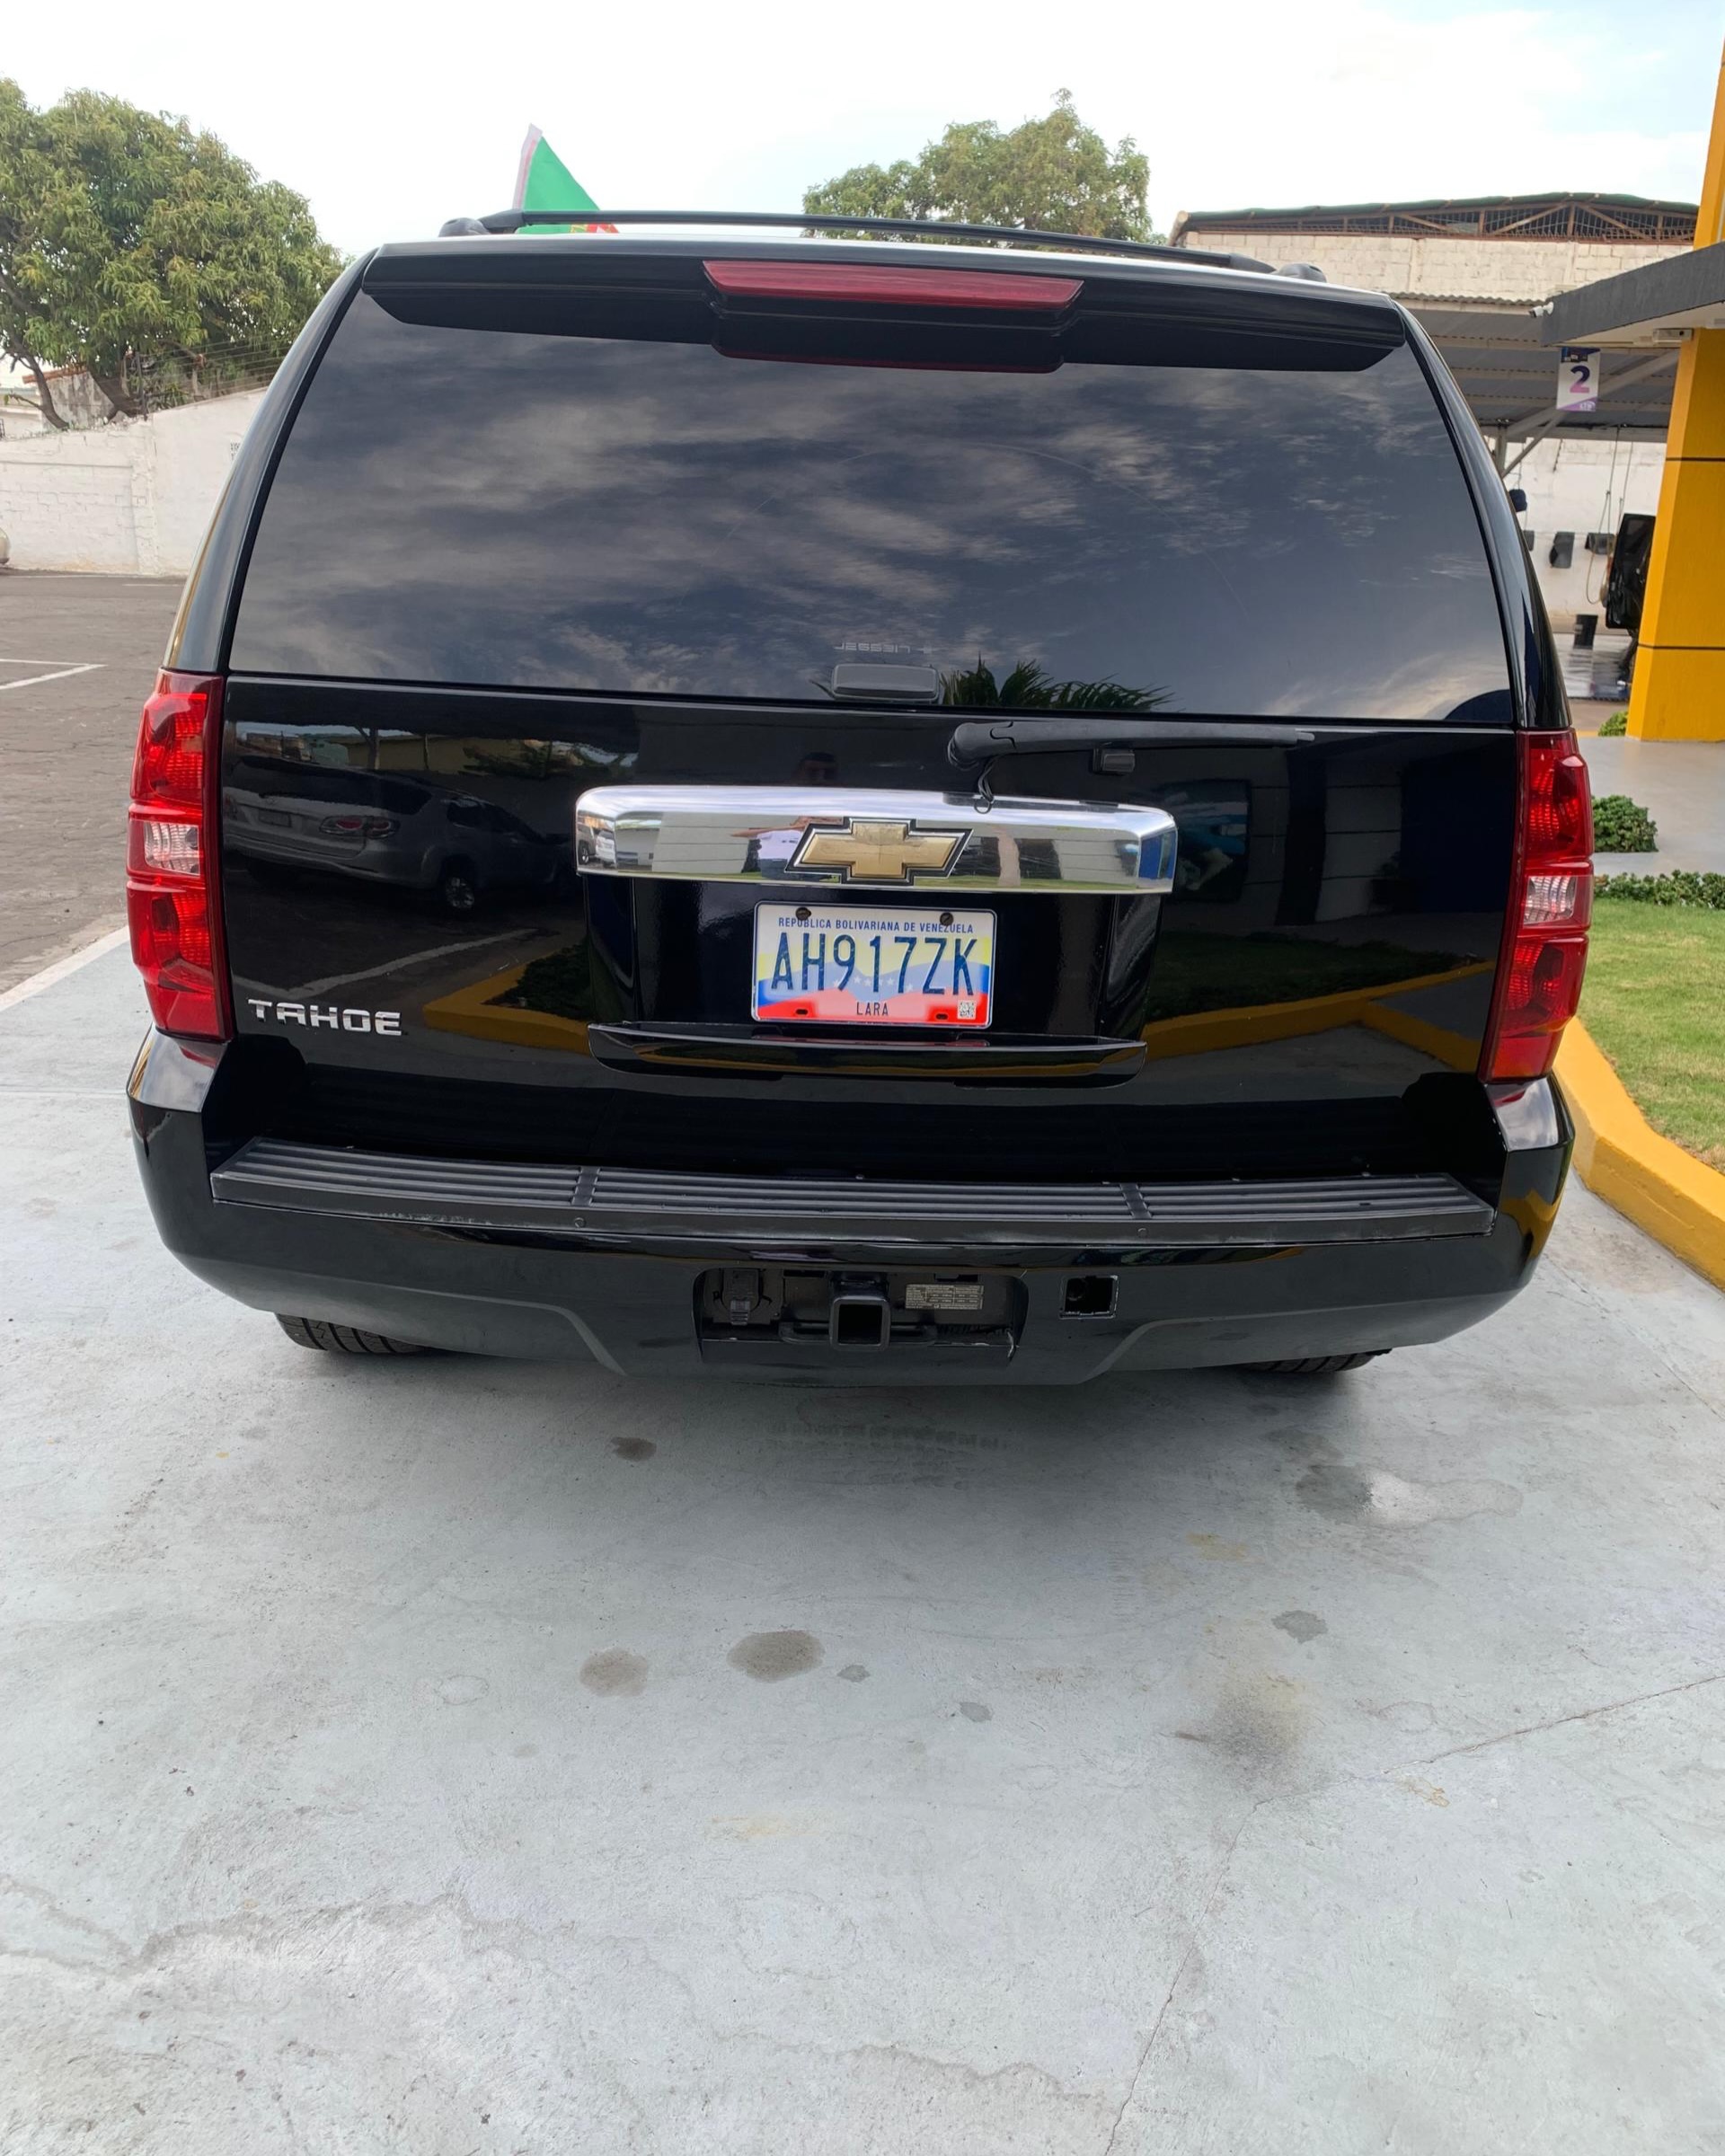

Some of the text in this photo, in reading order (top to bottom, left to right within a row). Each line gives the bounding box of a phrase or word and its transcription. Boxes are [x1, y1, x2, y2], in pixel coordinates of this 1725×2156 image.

[1570, 365, 1590, 393] 2
[836, 919, 899, 932] BOLIVARIANA
[904, 922, 916, 932] DE
[919, 923, 974, 934] VENEZUELA
[771, 932, 978, 995] AH917ZK
[248, 998, 402, 1036] TAHOE
[856, 1002, 889, 1016] LARA
